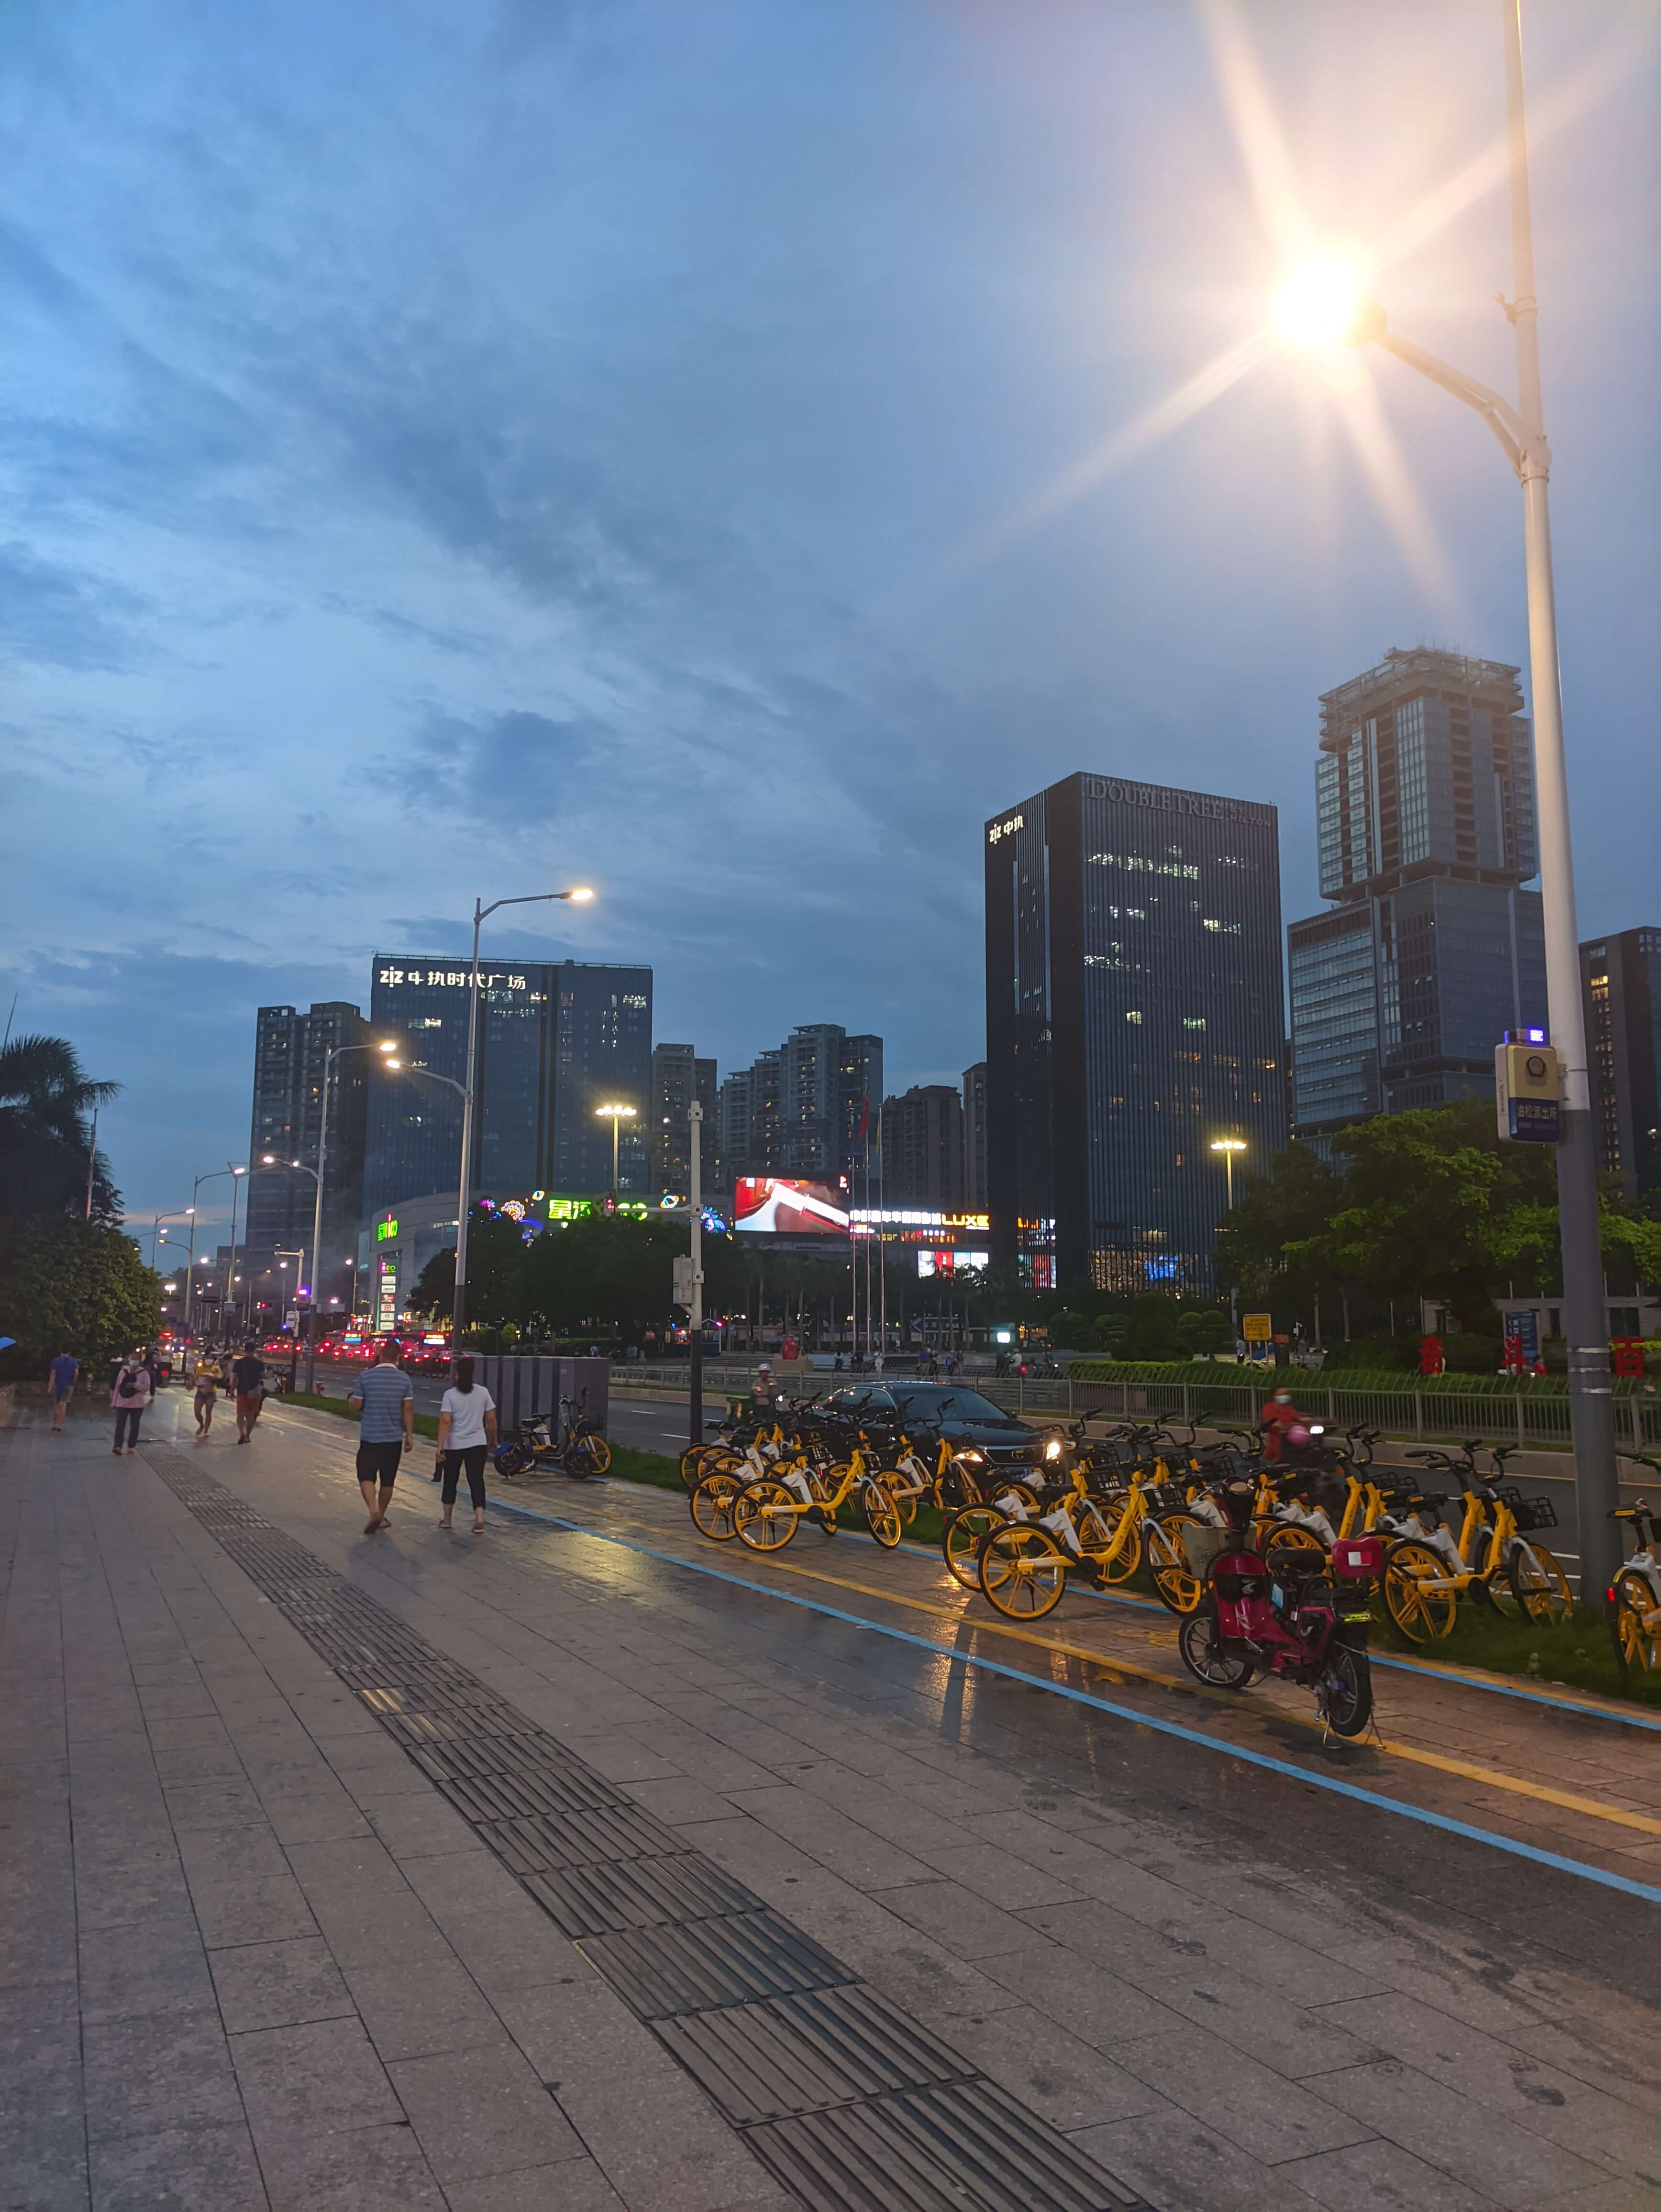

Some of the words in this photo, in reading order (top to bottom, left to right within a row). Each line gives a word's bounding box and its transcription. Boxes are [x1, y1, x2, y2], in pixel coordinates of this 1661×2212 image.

[1087, 777, 1224, 819] DOUBLETREE
[1229, 815, 1271, 828] HILTON
[941, 1213, 989, 1227] LUXE
[1613, 1336, 1644, 1380] 百
